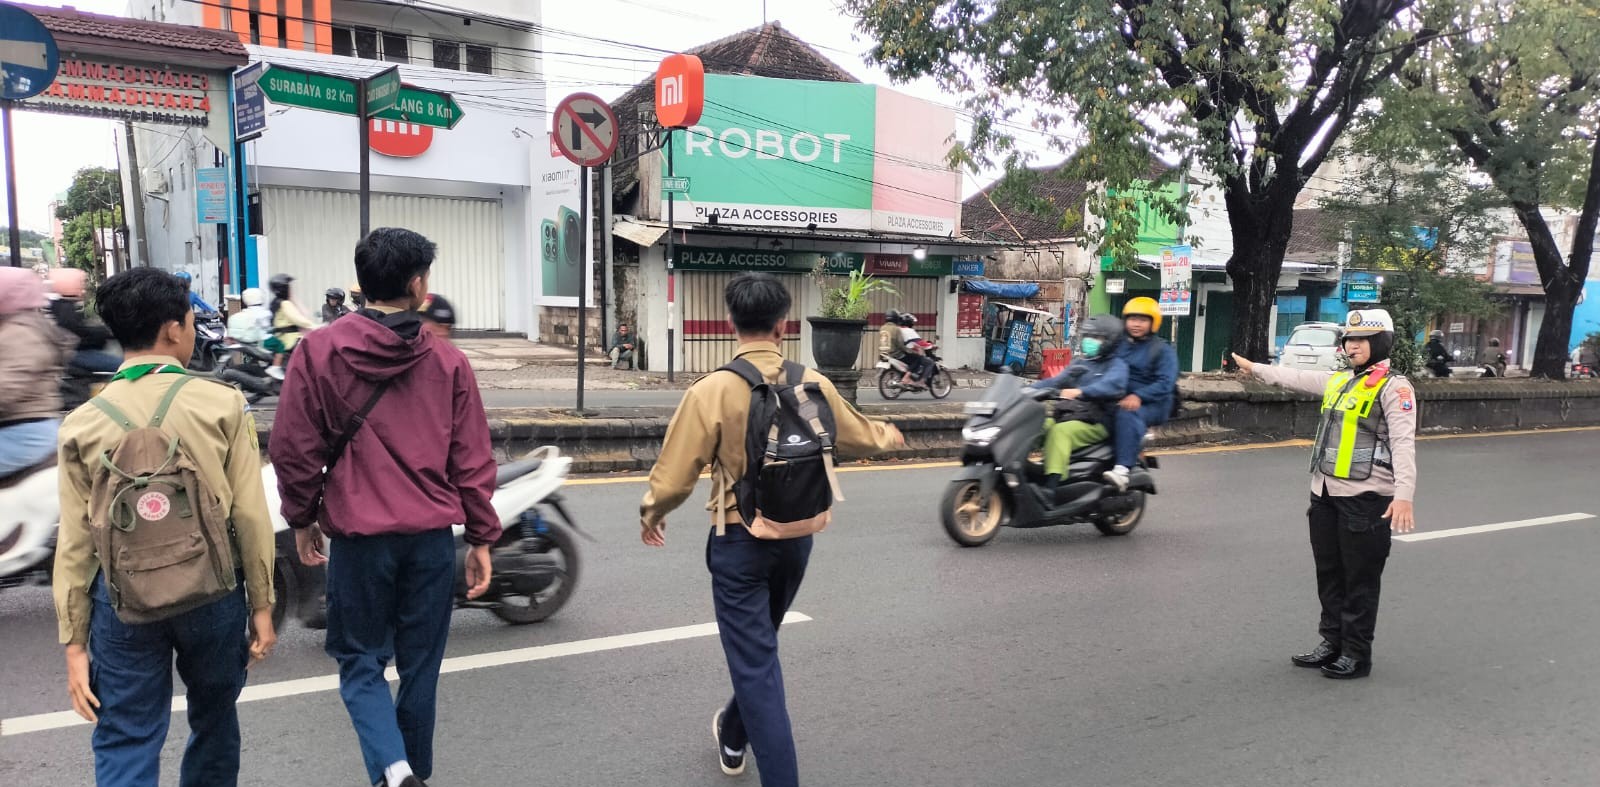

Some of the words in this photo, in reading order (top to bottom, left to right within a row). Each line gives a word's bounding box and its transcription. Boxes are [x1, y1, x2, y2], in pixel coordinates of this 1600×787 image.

[57, 59, 193, 89] MMADIYAH
[40, 80, 194, 111] AMMADIYAH
[200, 96, 211, 113] 4
[269, 78, 322, 99] SURABAYA
[338, 91, 354, 104] Km
[391, 97, 424, 114] LANG
[427, 101, 434, 116] 8
[436, 103, 453, 119] Km
[685, 125, 851, 164] ROBOT
[695, 206, 739, 221] PLAZA
[743, 209, 838, 225] ACCESSORIES
[887, 215, 906, 229] PLAZA
[907, 217, 944, 232] ACCESSORIES
[681, 252, 725, 266] PLAZA
